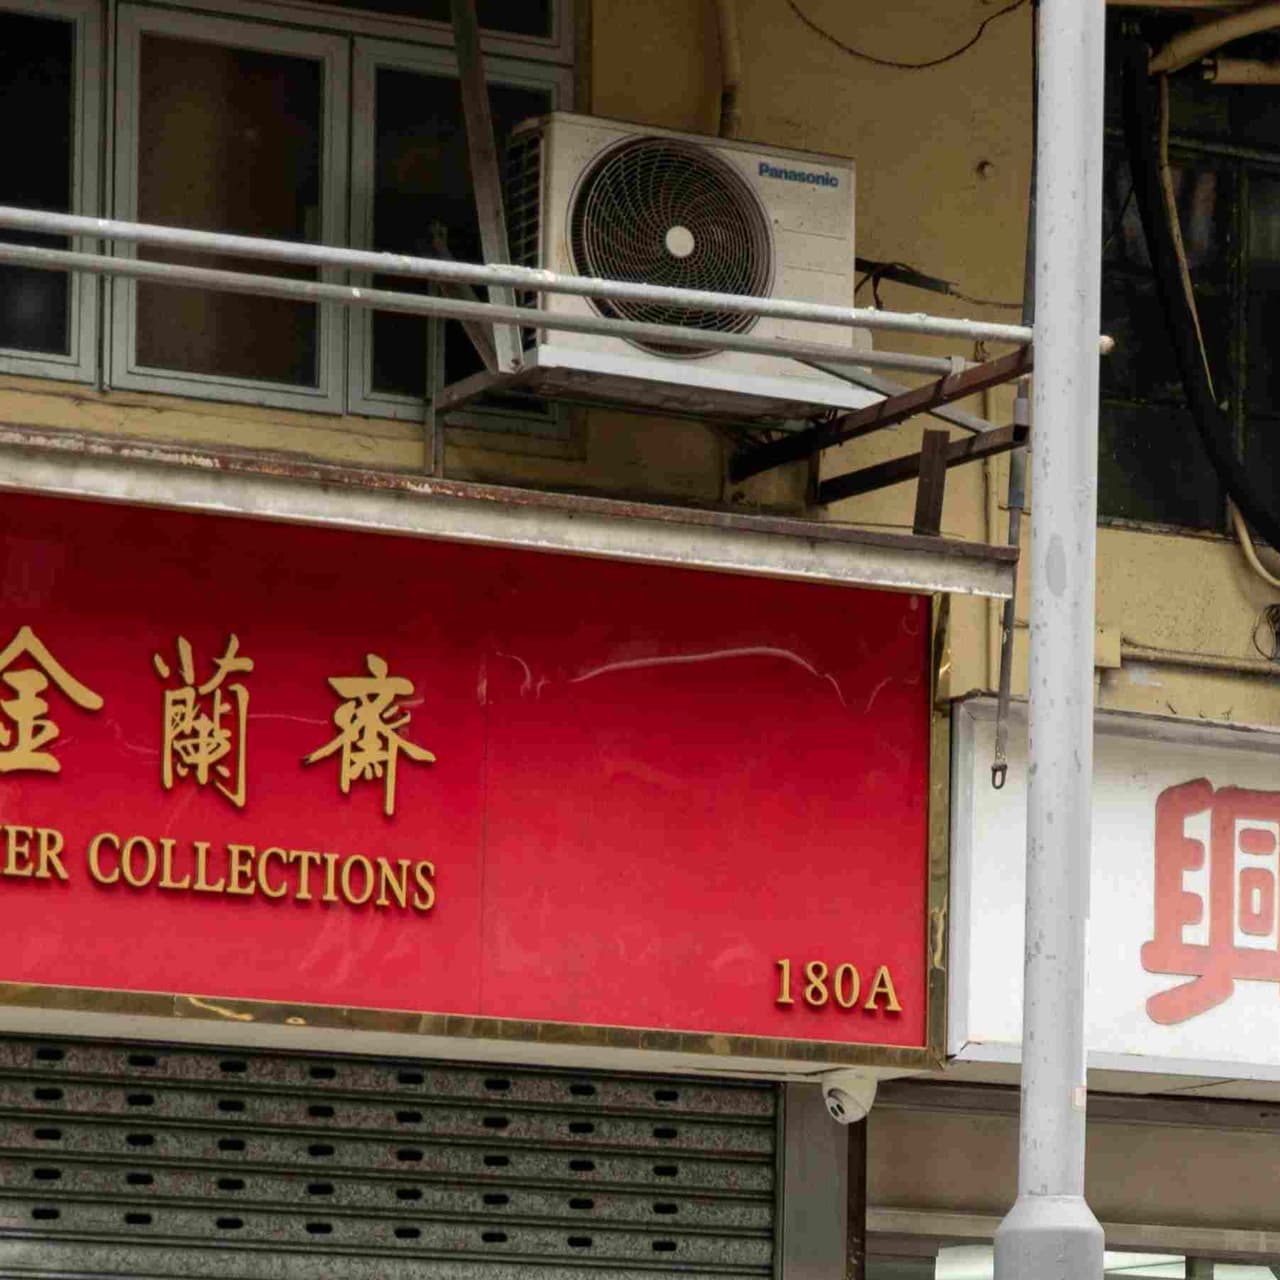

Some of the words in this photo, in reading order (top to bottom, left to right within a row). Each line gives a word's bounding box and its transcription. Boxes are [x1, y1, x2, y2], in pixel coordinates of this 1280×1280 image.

[758, 161, 839, 189] Panasonic
[0, 825, 69, 881] ER
[89, 831, 437, 912] COLLECTIONS
[775, 957, 903, 1014] 180A
